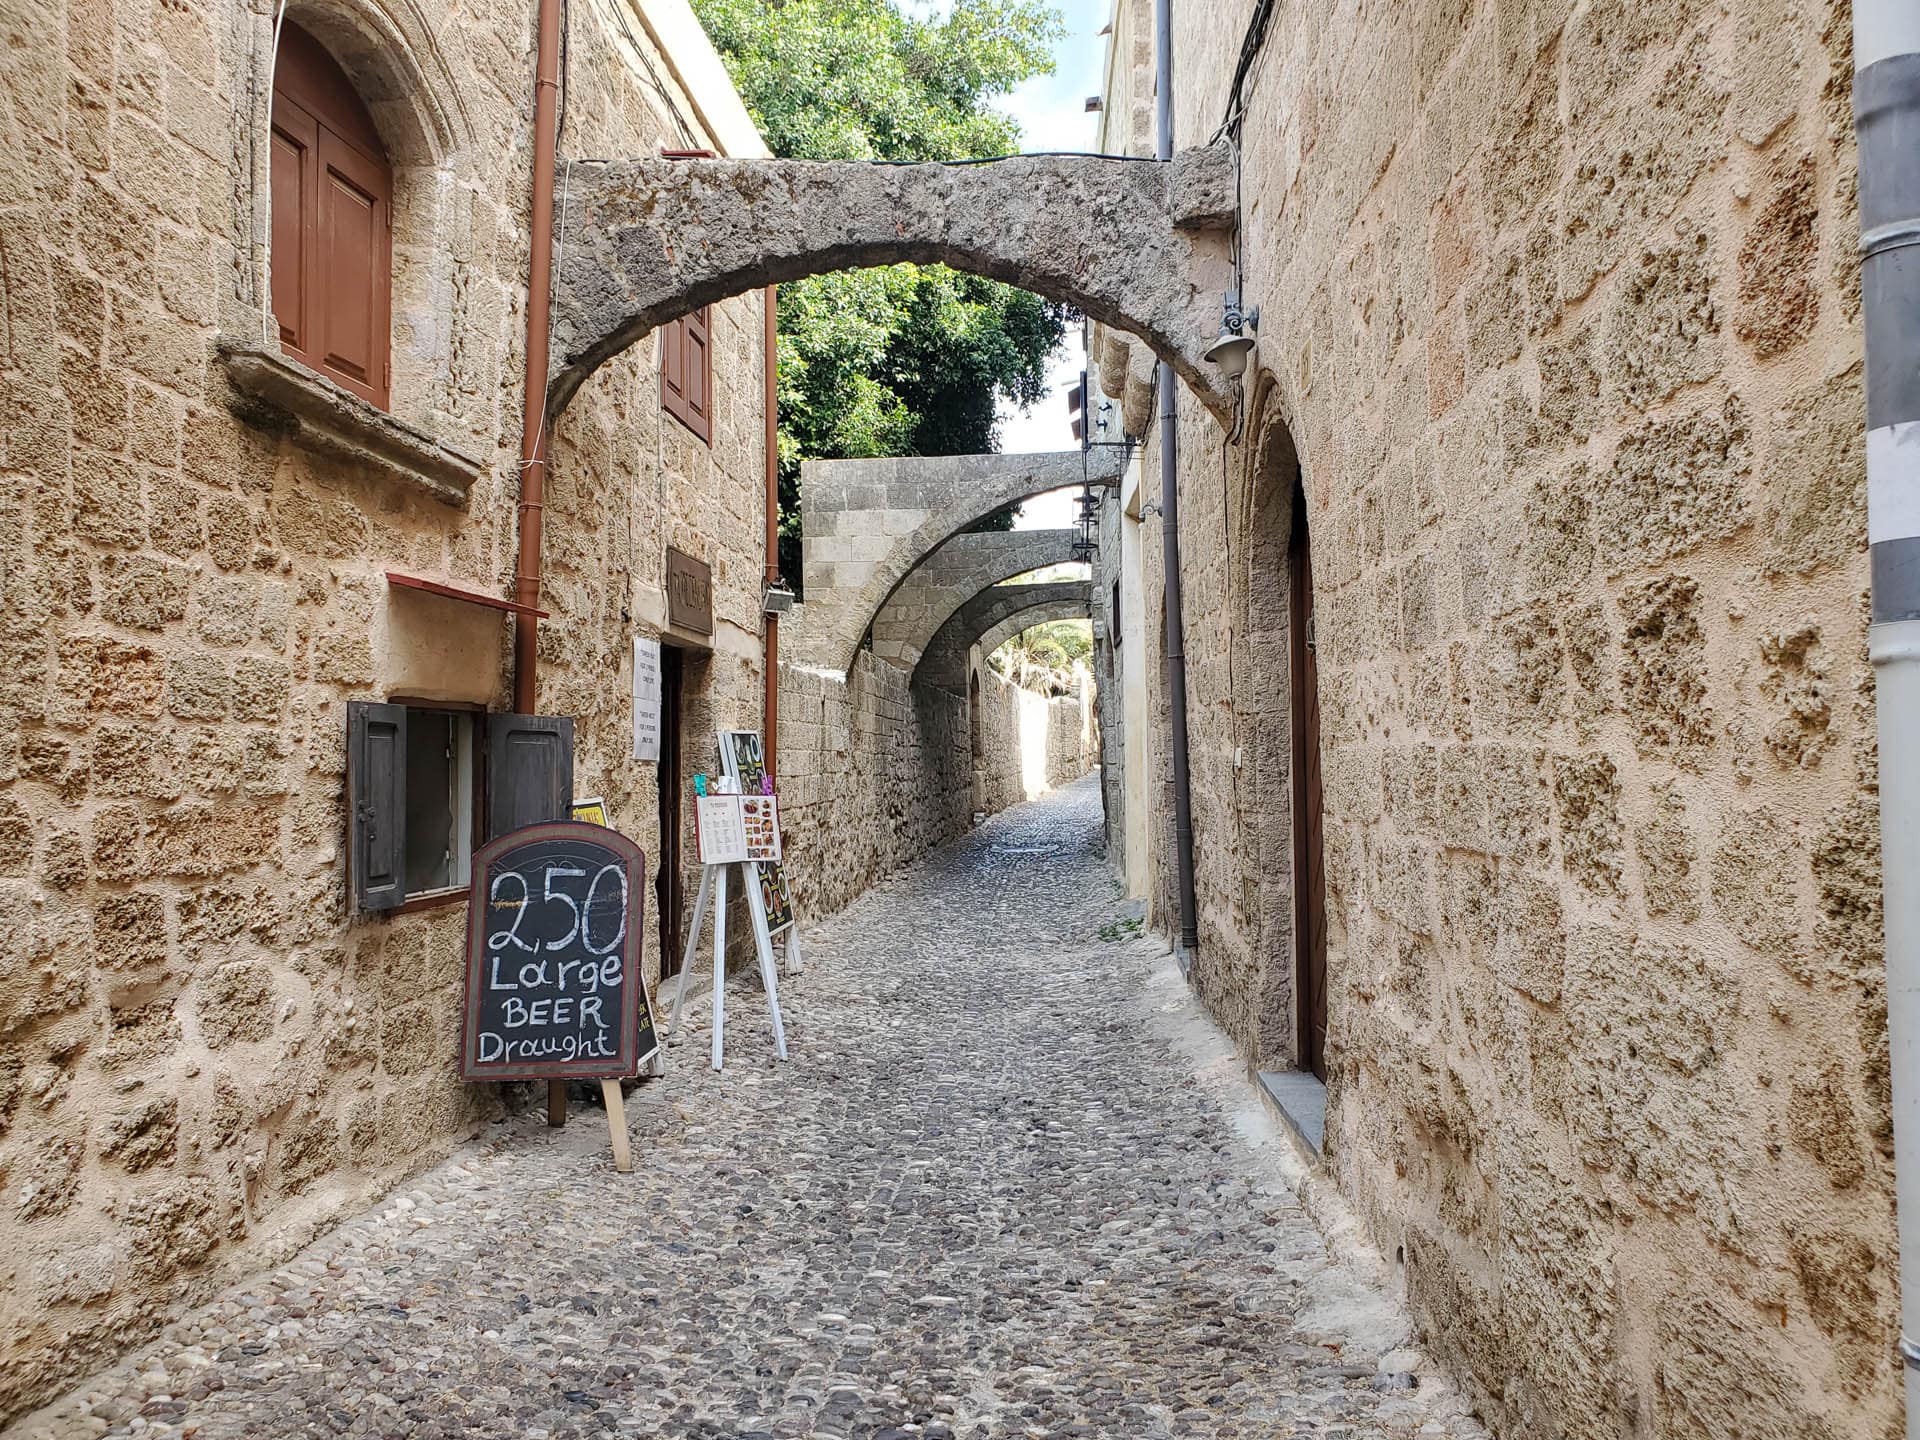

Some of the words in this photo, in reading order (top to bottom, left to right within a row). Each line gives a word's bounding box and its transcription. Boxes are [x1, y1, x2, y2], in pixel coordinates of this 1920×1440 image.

[488, 864, 628, 955] 2,50
[490, 956, 623, 993] Large
[501, 996, 610, 1029] BEER
[477, 1030, 616, 1063] Draught
